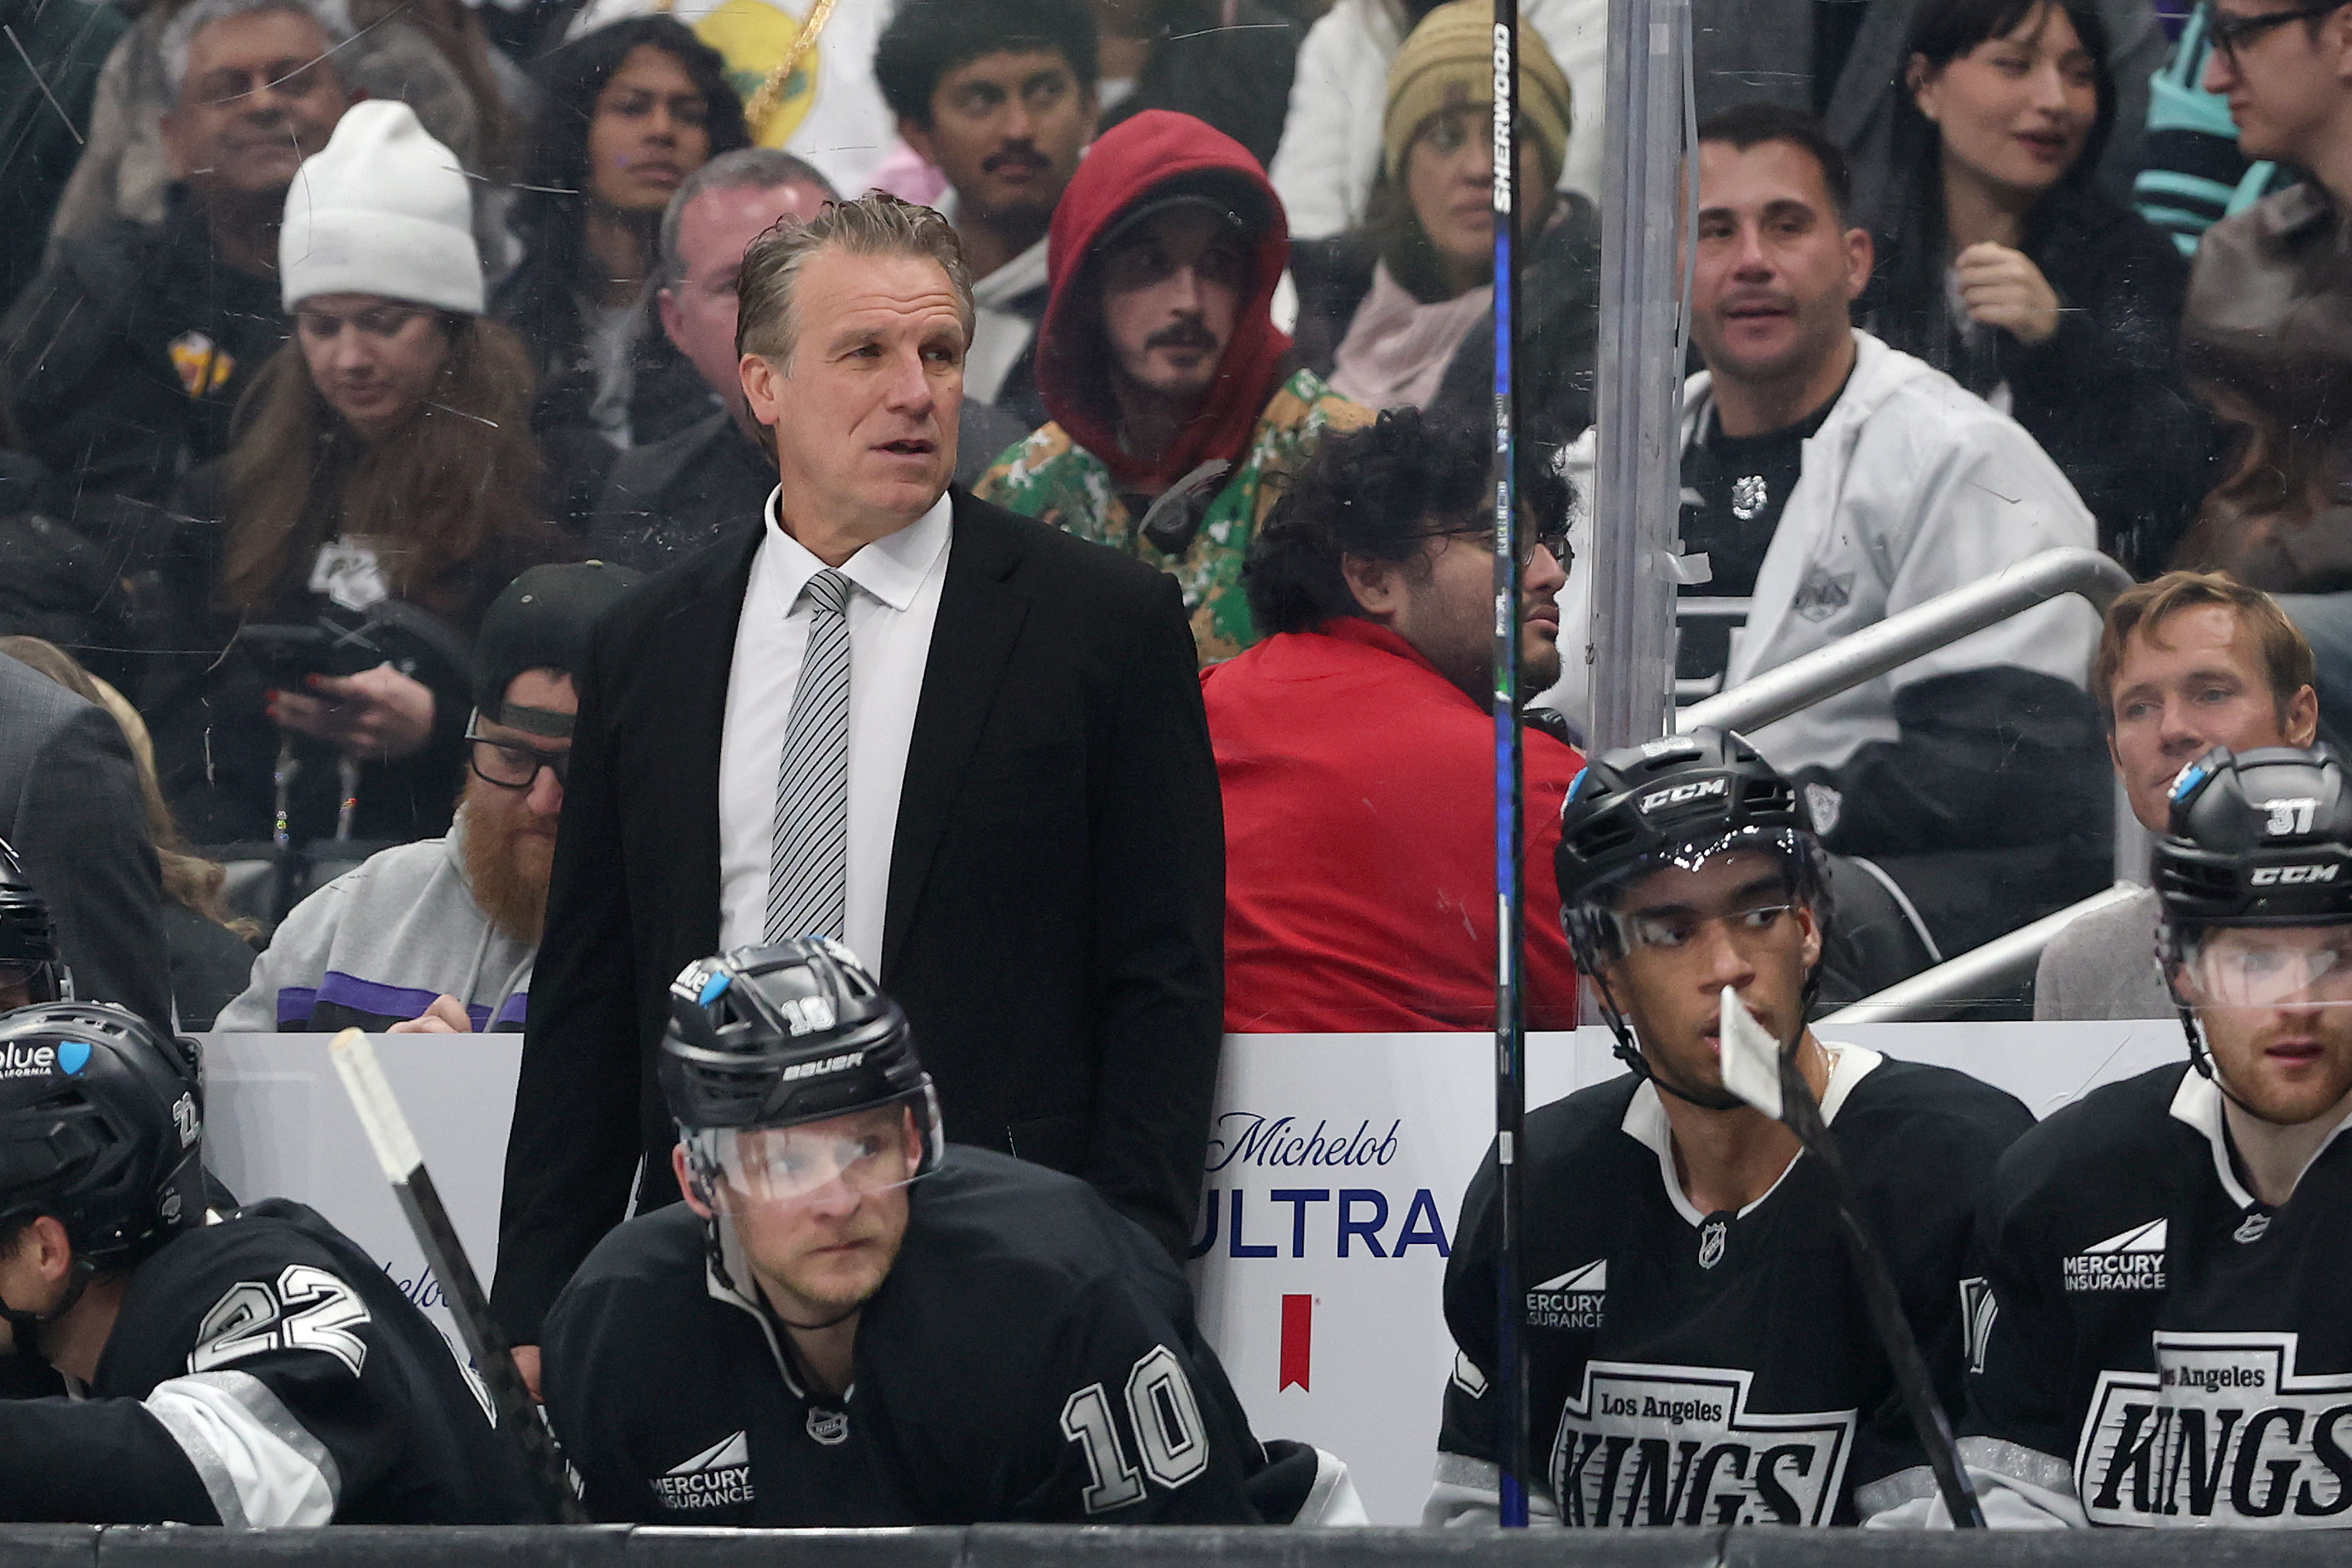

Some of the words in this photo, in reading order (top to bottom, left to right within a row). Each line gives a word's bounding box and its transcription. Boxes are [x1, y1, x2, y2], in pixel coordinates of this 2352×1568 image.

[1493, 22, 1512, 214] SHERWOOD
[1640, 778, 1729, 815] CCM
[2264, 796, 2317, 836] 37
[2250, 864, 2340, 886] CCM
[782, 995, 836, 1036] 10
[1204, 1111, 1401, 1173] Michelob
[2063, 1254, 2166, 1275] MERCURY
[2064, 1273, 2166, 1291] INSURANCE
[187, 1264, 372, 1379] 22
[1526, 1294, 1606, 1312] ERCURY
[1526, 1311, 1604, 1328] SURANCE
[2179, 1366, 2266, 1393] Angeles
[1601, 1392, 1638, 1416] Los
[1642, 1396, 1723, 1425] Angeles
[1060, 1343, 1209, 1515] 10
[1561, 1429, 1817, 1527] KINGS
